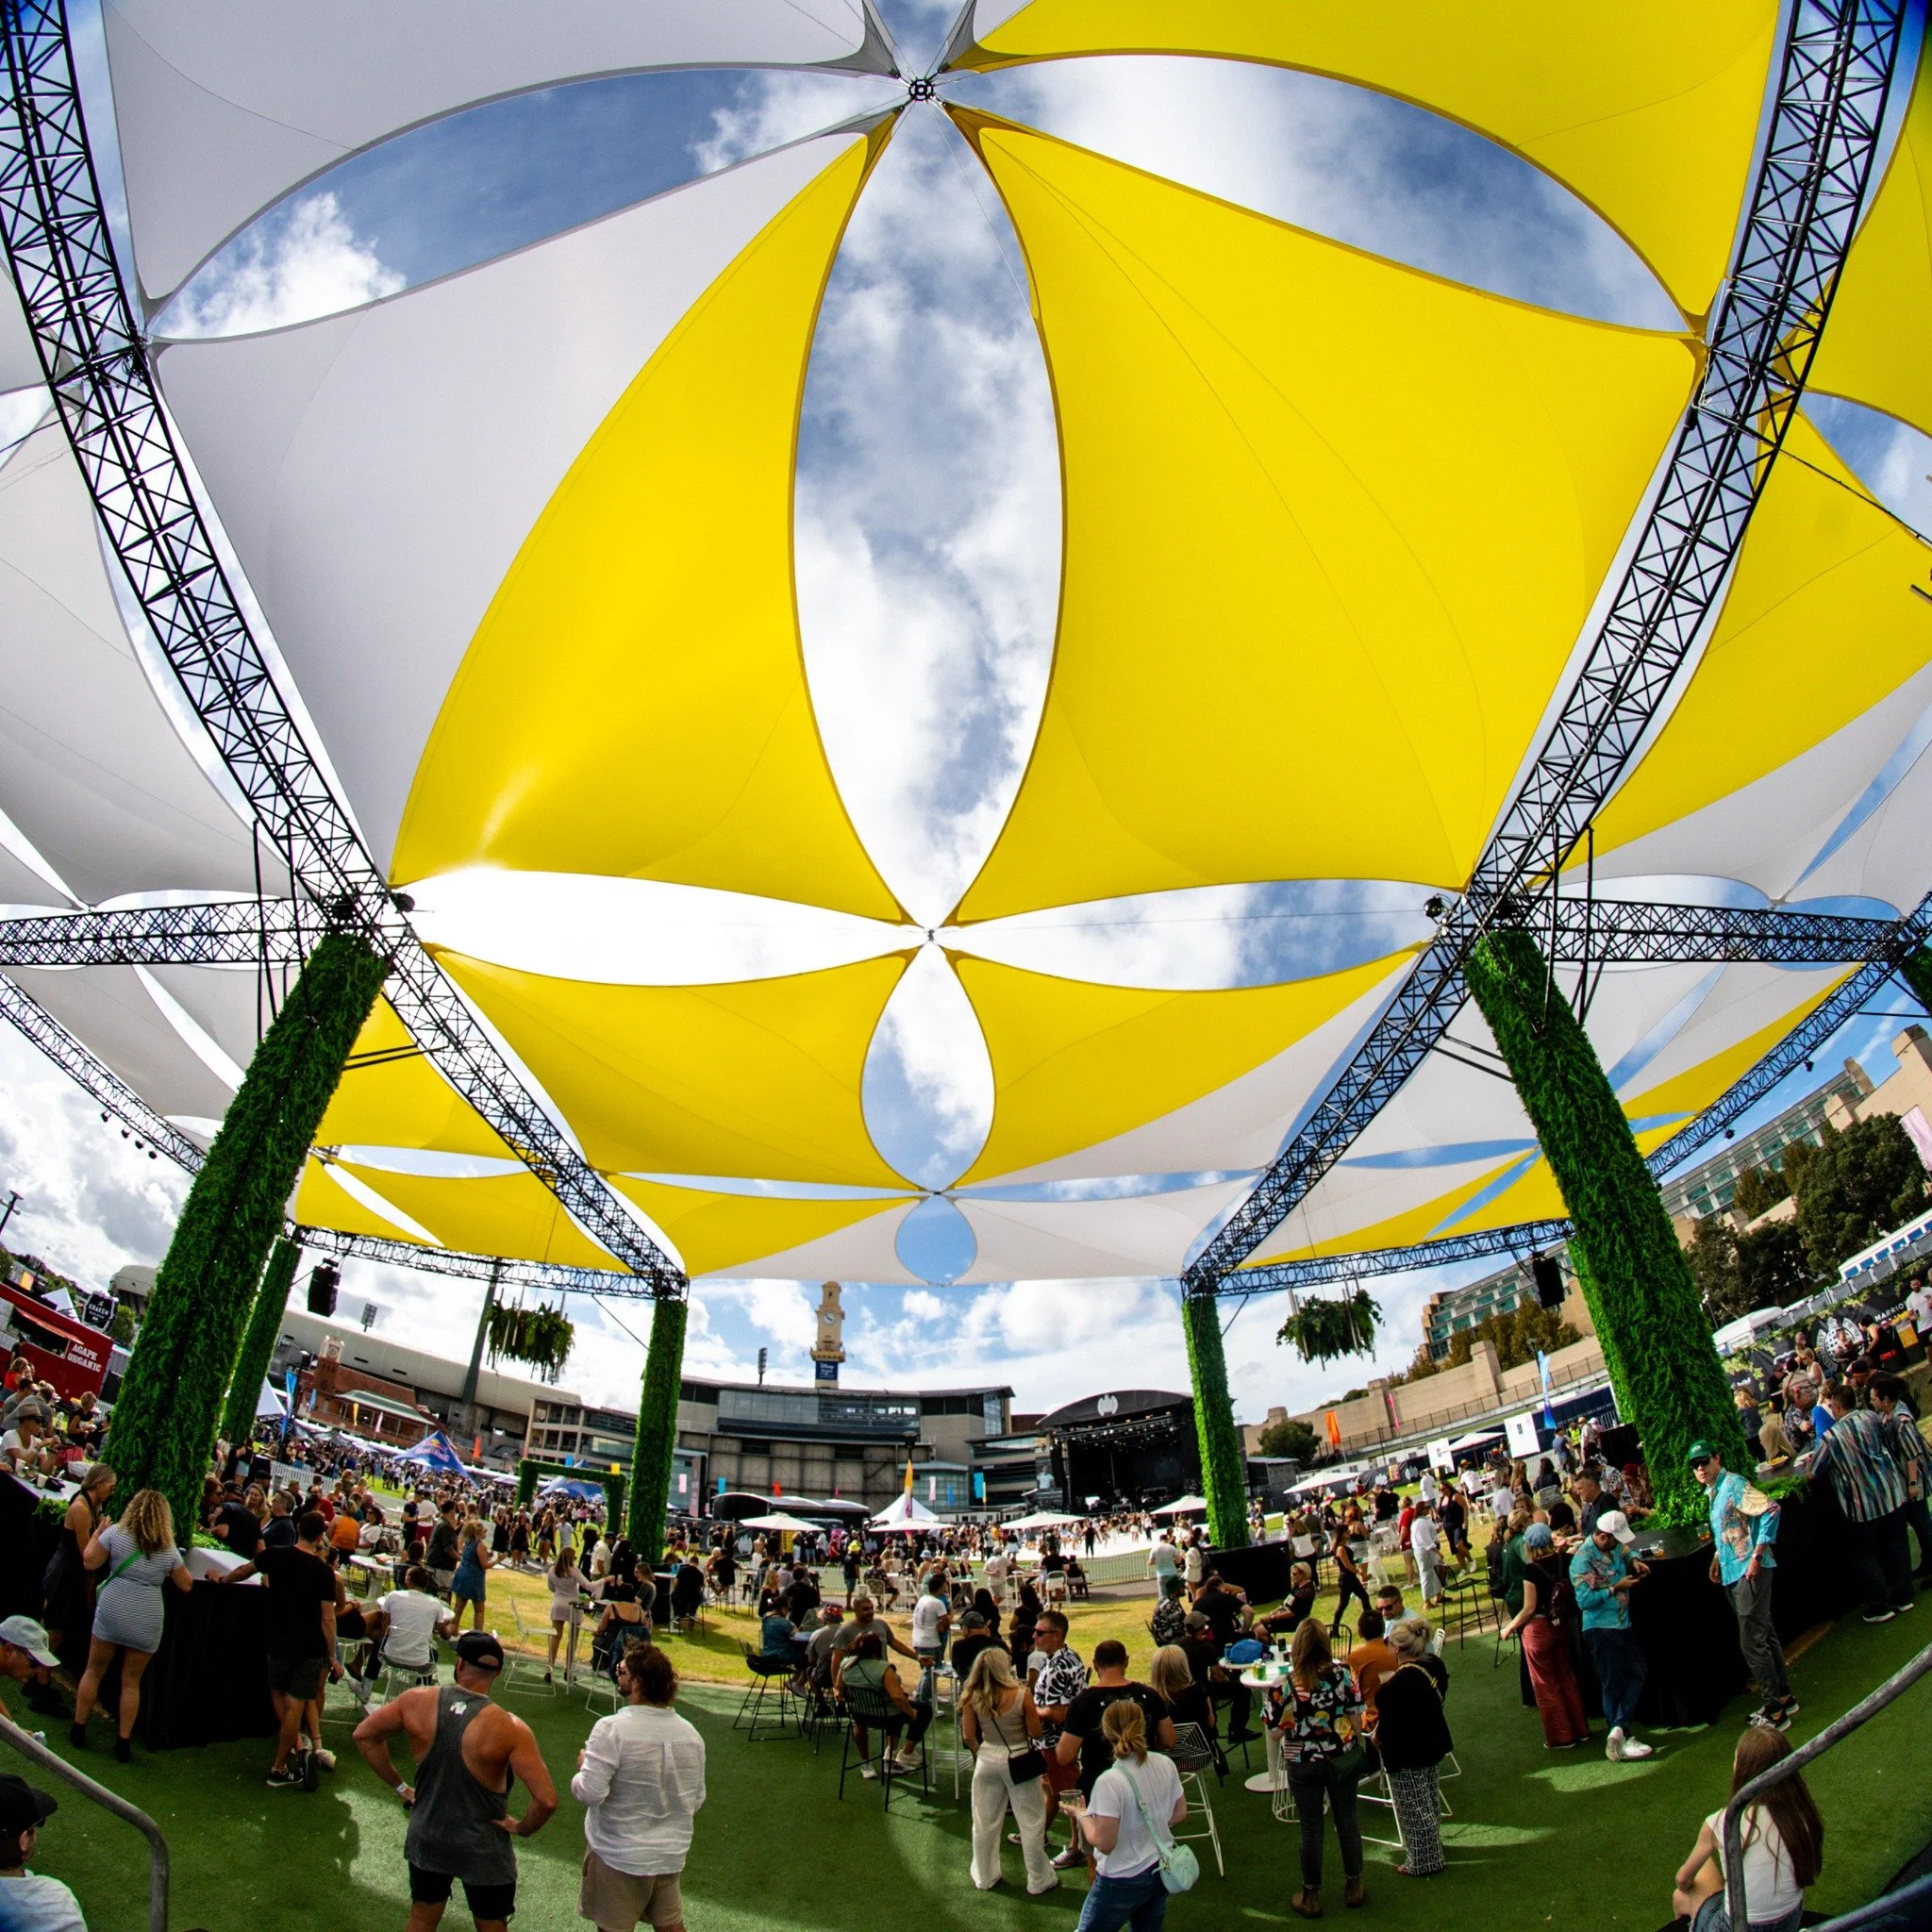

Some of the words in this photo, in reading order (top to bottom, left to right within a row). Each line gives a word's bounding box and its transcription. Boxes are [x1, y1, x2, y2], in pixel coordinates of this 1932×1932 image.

[88, 1303, 109, 1316] KRAKEN
[72, 1343, 98, 1360] AGAPE
[67, 1353, 102, 1373] ORGANIC
